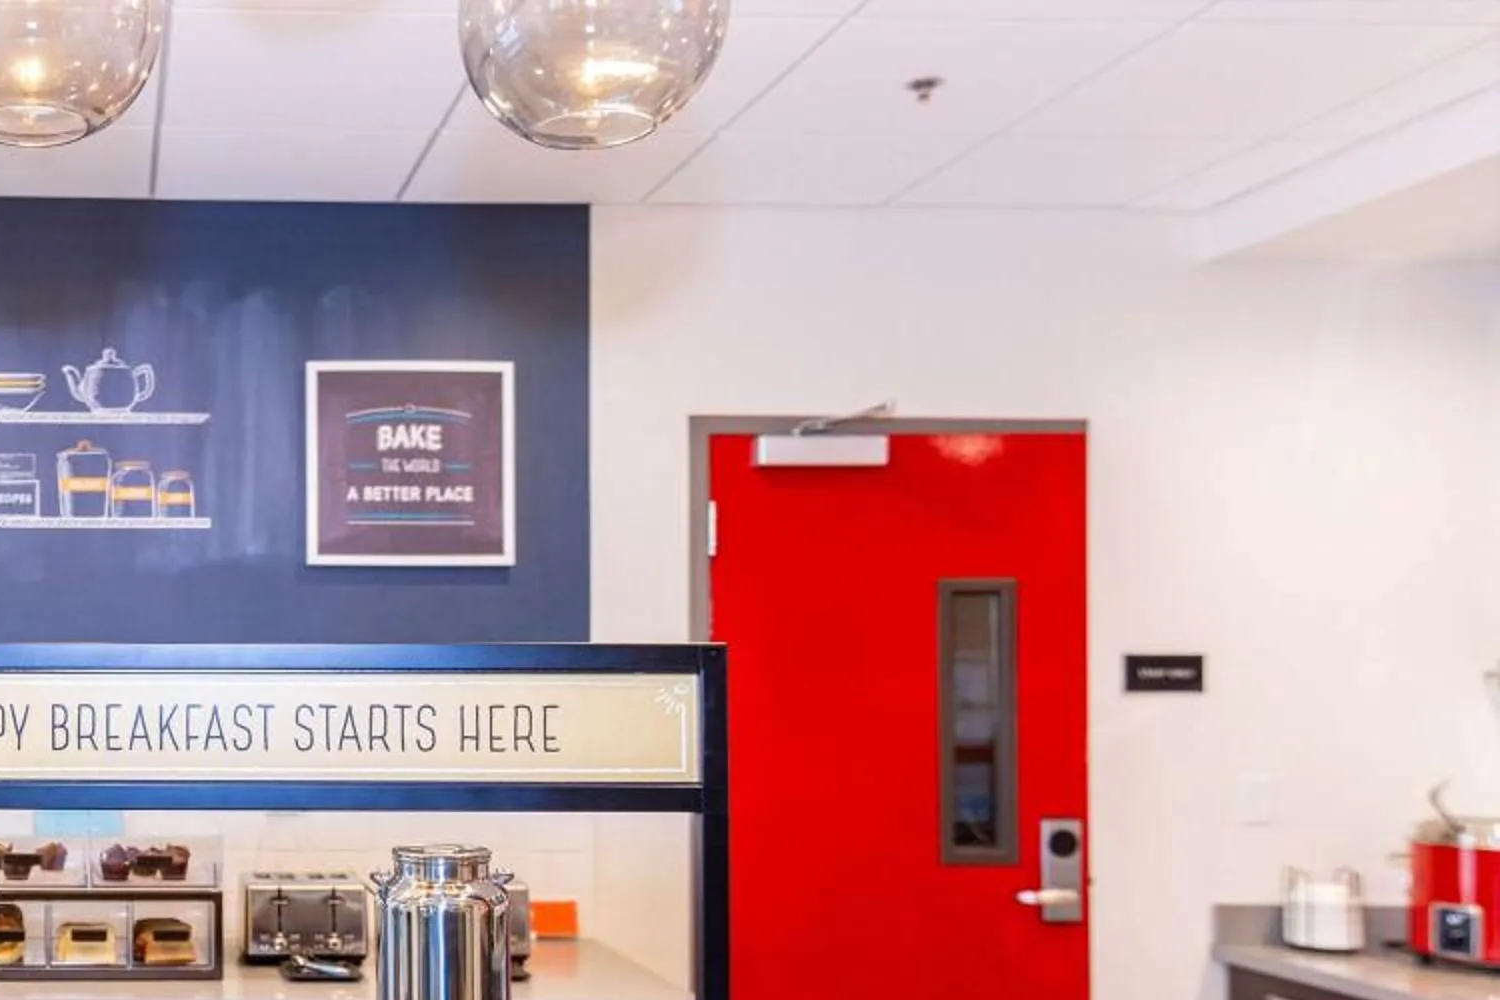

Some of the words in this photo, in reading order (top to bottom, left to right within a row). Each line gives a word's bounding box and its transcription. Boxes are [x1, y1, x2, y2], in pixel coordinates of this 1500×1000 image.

[377, 424, 442, 451] BAKE
[346, 485, 359, 501] A
[363, 485, 420, 502] BETTER
[425, 485, 474, 502] PLACE
[51, 703, 275, 752] BREAKFAST
[294, 704, 437, 752] STARTS
[459, 704, 561, 752] HERE
